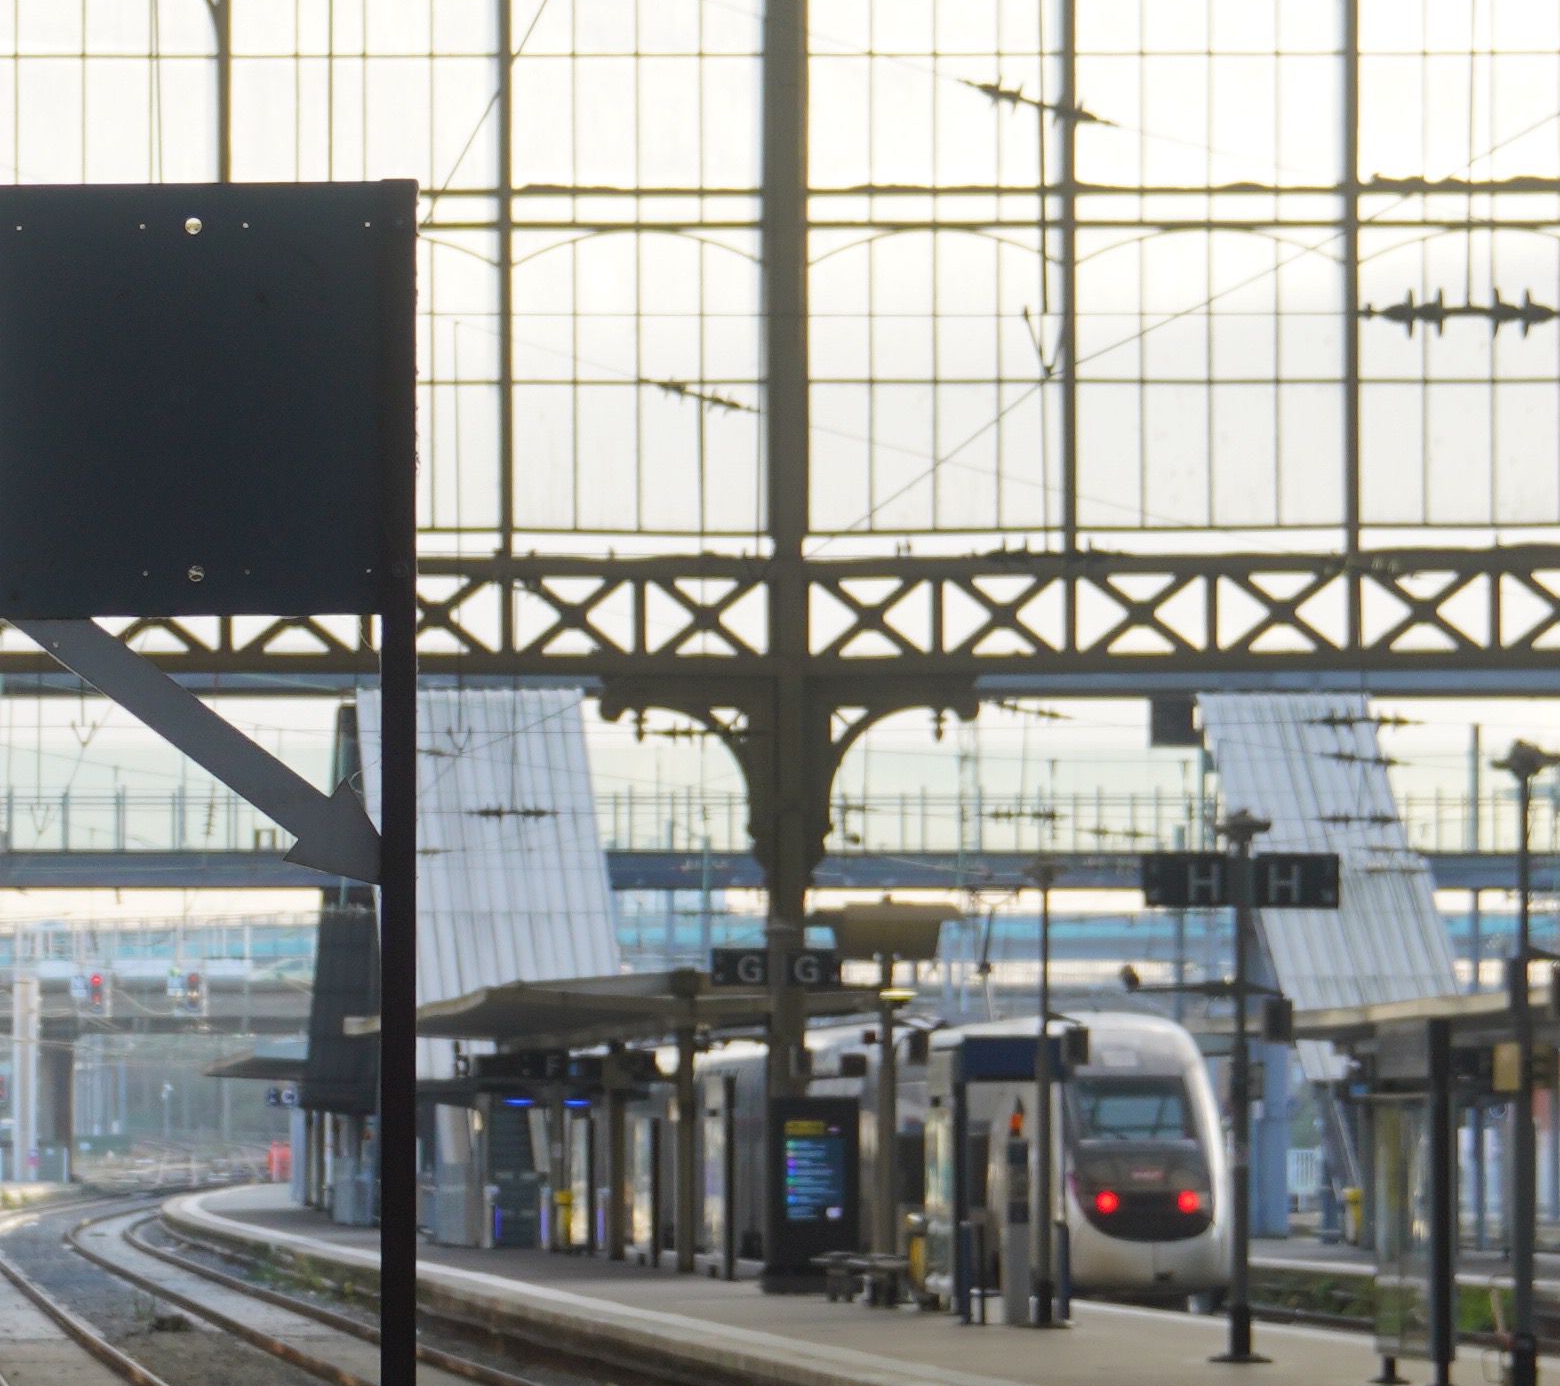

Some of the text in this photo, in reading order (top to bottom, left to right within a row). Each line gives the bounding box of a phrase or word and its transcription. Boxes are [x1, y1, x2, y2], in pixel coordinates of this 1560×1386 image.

[1187, 863, 1222, 902] H
[1268, 863, 1302, 903] H
[738, 954, 764, 983] G
[794, 954, 820, 983] G
